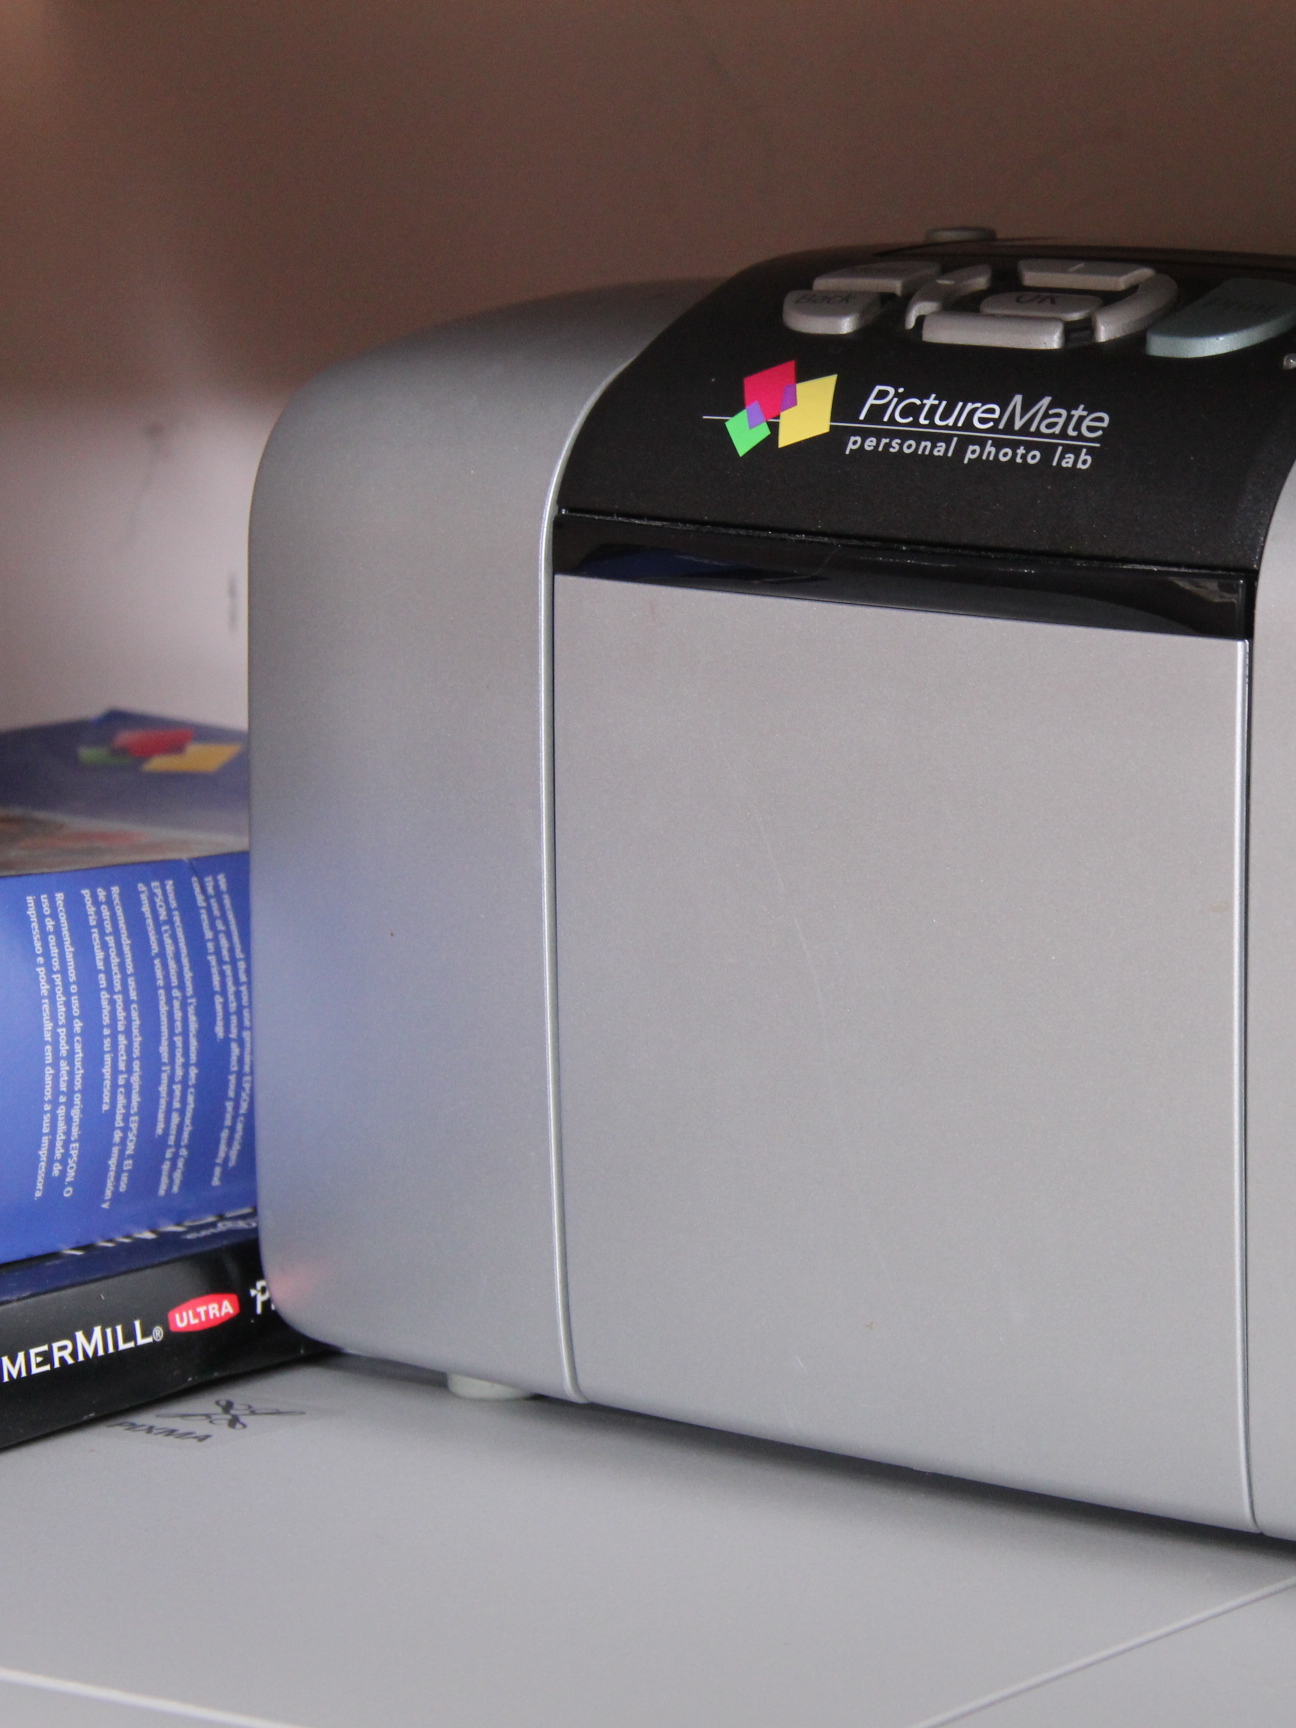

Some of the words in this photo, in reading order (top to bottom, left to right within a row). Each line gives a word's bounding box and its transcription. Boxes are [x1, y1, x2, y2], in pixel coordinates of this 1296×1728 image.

[858, 384, 1110, 439] PictureMate
[846, 433, 954, 457] personal
[964, 443, 1041, 466] photo
[1052, 446, 1093, 470] lab
[41, 895, 50, 915] uso
[100, 904, 112, 933] otros
[55, 893, 76, 982] Recomendamos
[110, 886, 134, 974] Recomendamos
[48, 935, 60, 971] outros
[105, 936, 123, 992] productos
[36, 967, 50, 996] pode
[52, 974, 66, 1025] produtos
[127, 977, 137, 1001] usar
[42, 999, 53, 1042] resultar
[71, 995, 80, 1016] uso
[91, 928, 104, 970] resultar
[102, 1053, 113, 1113] impresora.
[57, 1028, 69, 1057] pode
[118, 1034, 128, 1072] afectar
[60, 1060, 69, 1092] afetar
[74, 1036, 84, 1091] cartuchos
[44, 1066, 55, 1101] danos
[42, 1113, 50, 1133] sua
[70, 1093, 83, 1141] originais
[115, 1087, 126, 1127] calidad
[54, 1105, 67, 1160] qualidade
[35, 1136, 51, 1200] impressora.
[65, 1143, 79, 1185] EPSON.
[119, 1172, 128, 1192] uso
[174, 1300, 234, 1328] ULTRA
[107, 1420, 213, 1443] PIXMA
